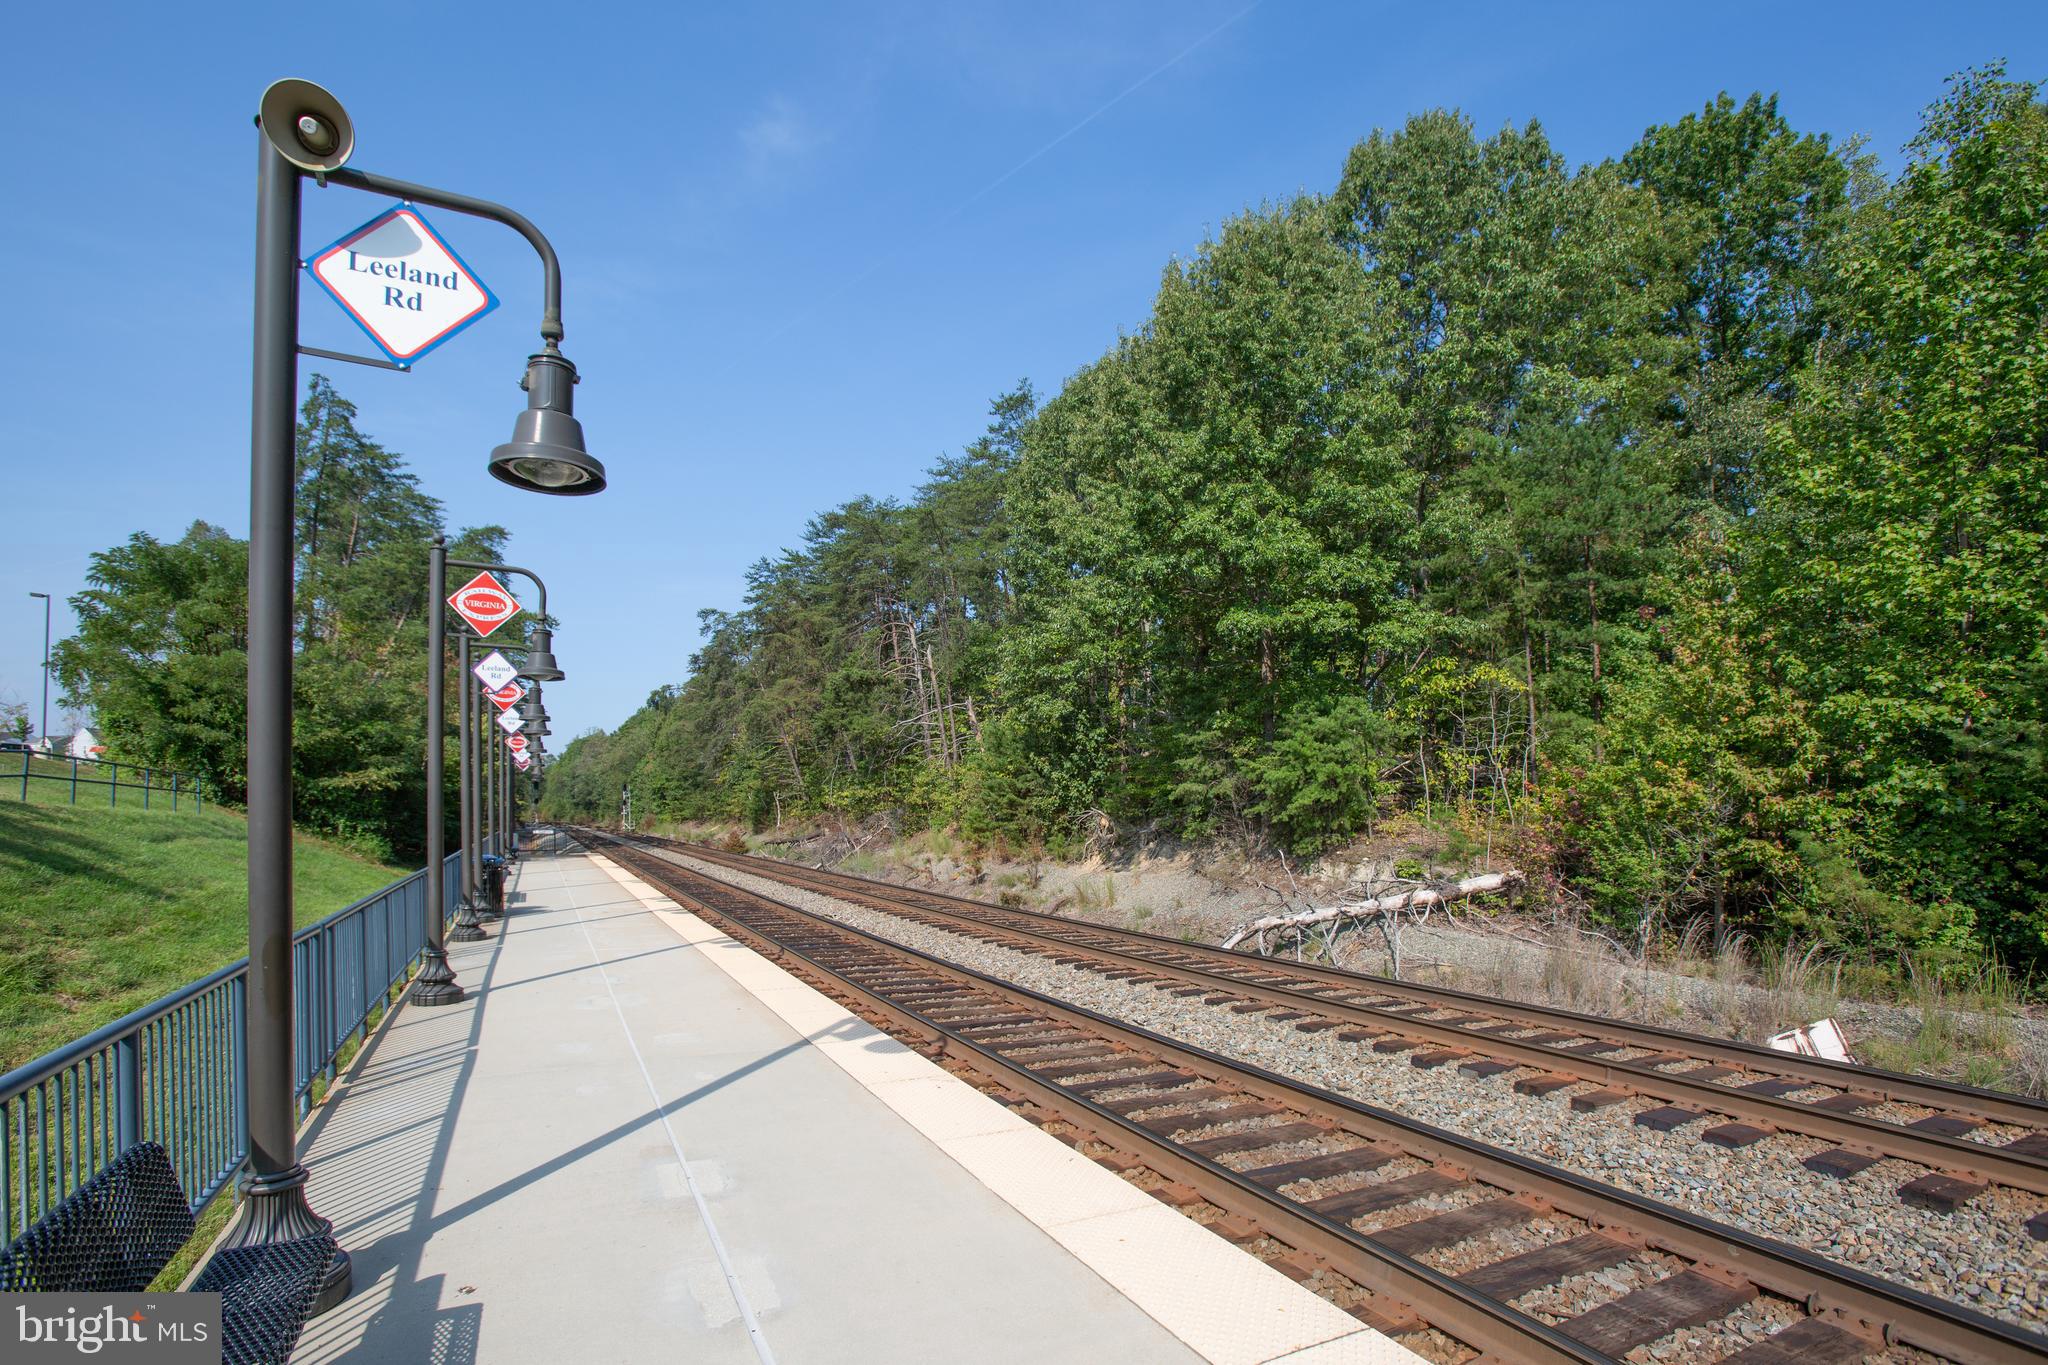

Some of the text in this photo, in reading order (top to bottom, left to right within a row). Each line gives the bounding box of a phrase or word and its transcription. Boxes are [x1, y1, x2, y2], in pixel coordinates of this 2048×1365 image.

[348, 250, 459, 291] Leeland
[383, 286, 423, 312] Rd
[464, 599, 506, 610] VIRGINIA
